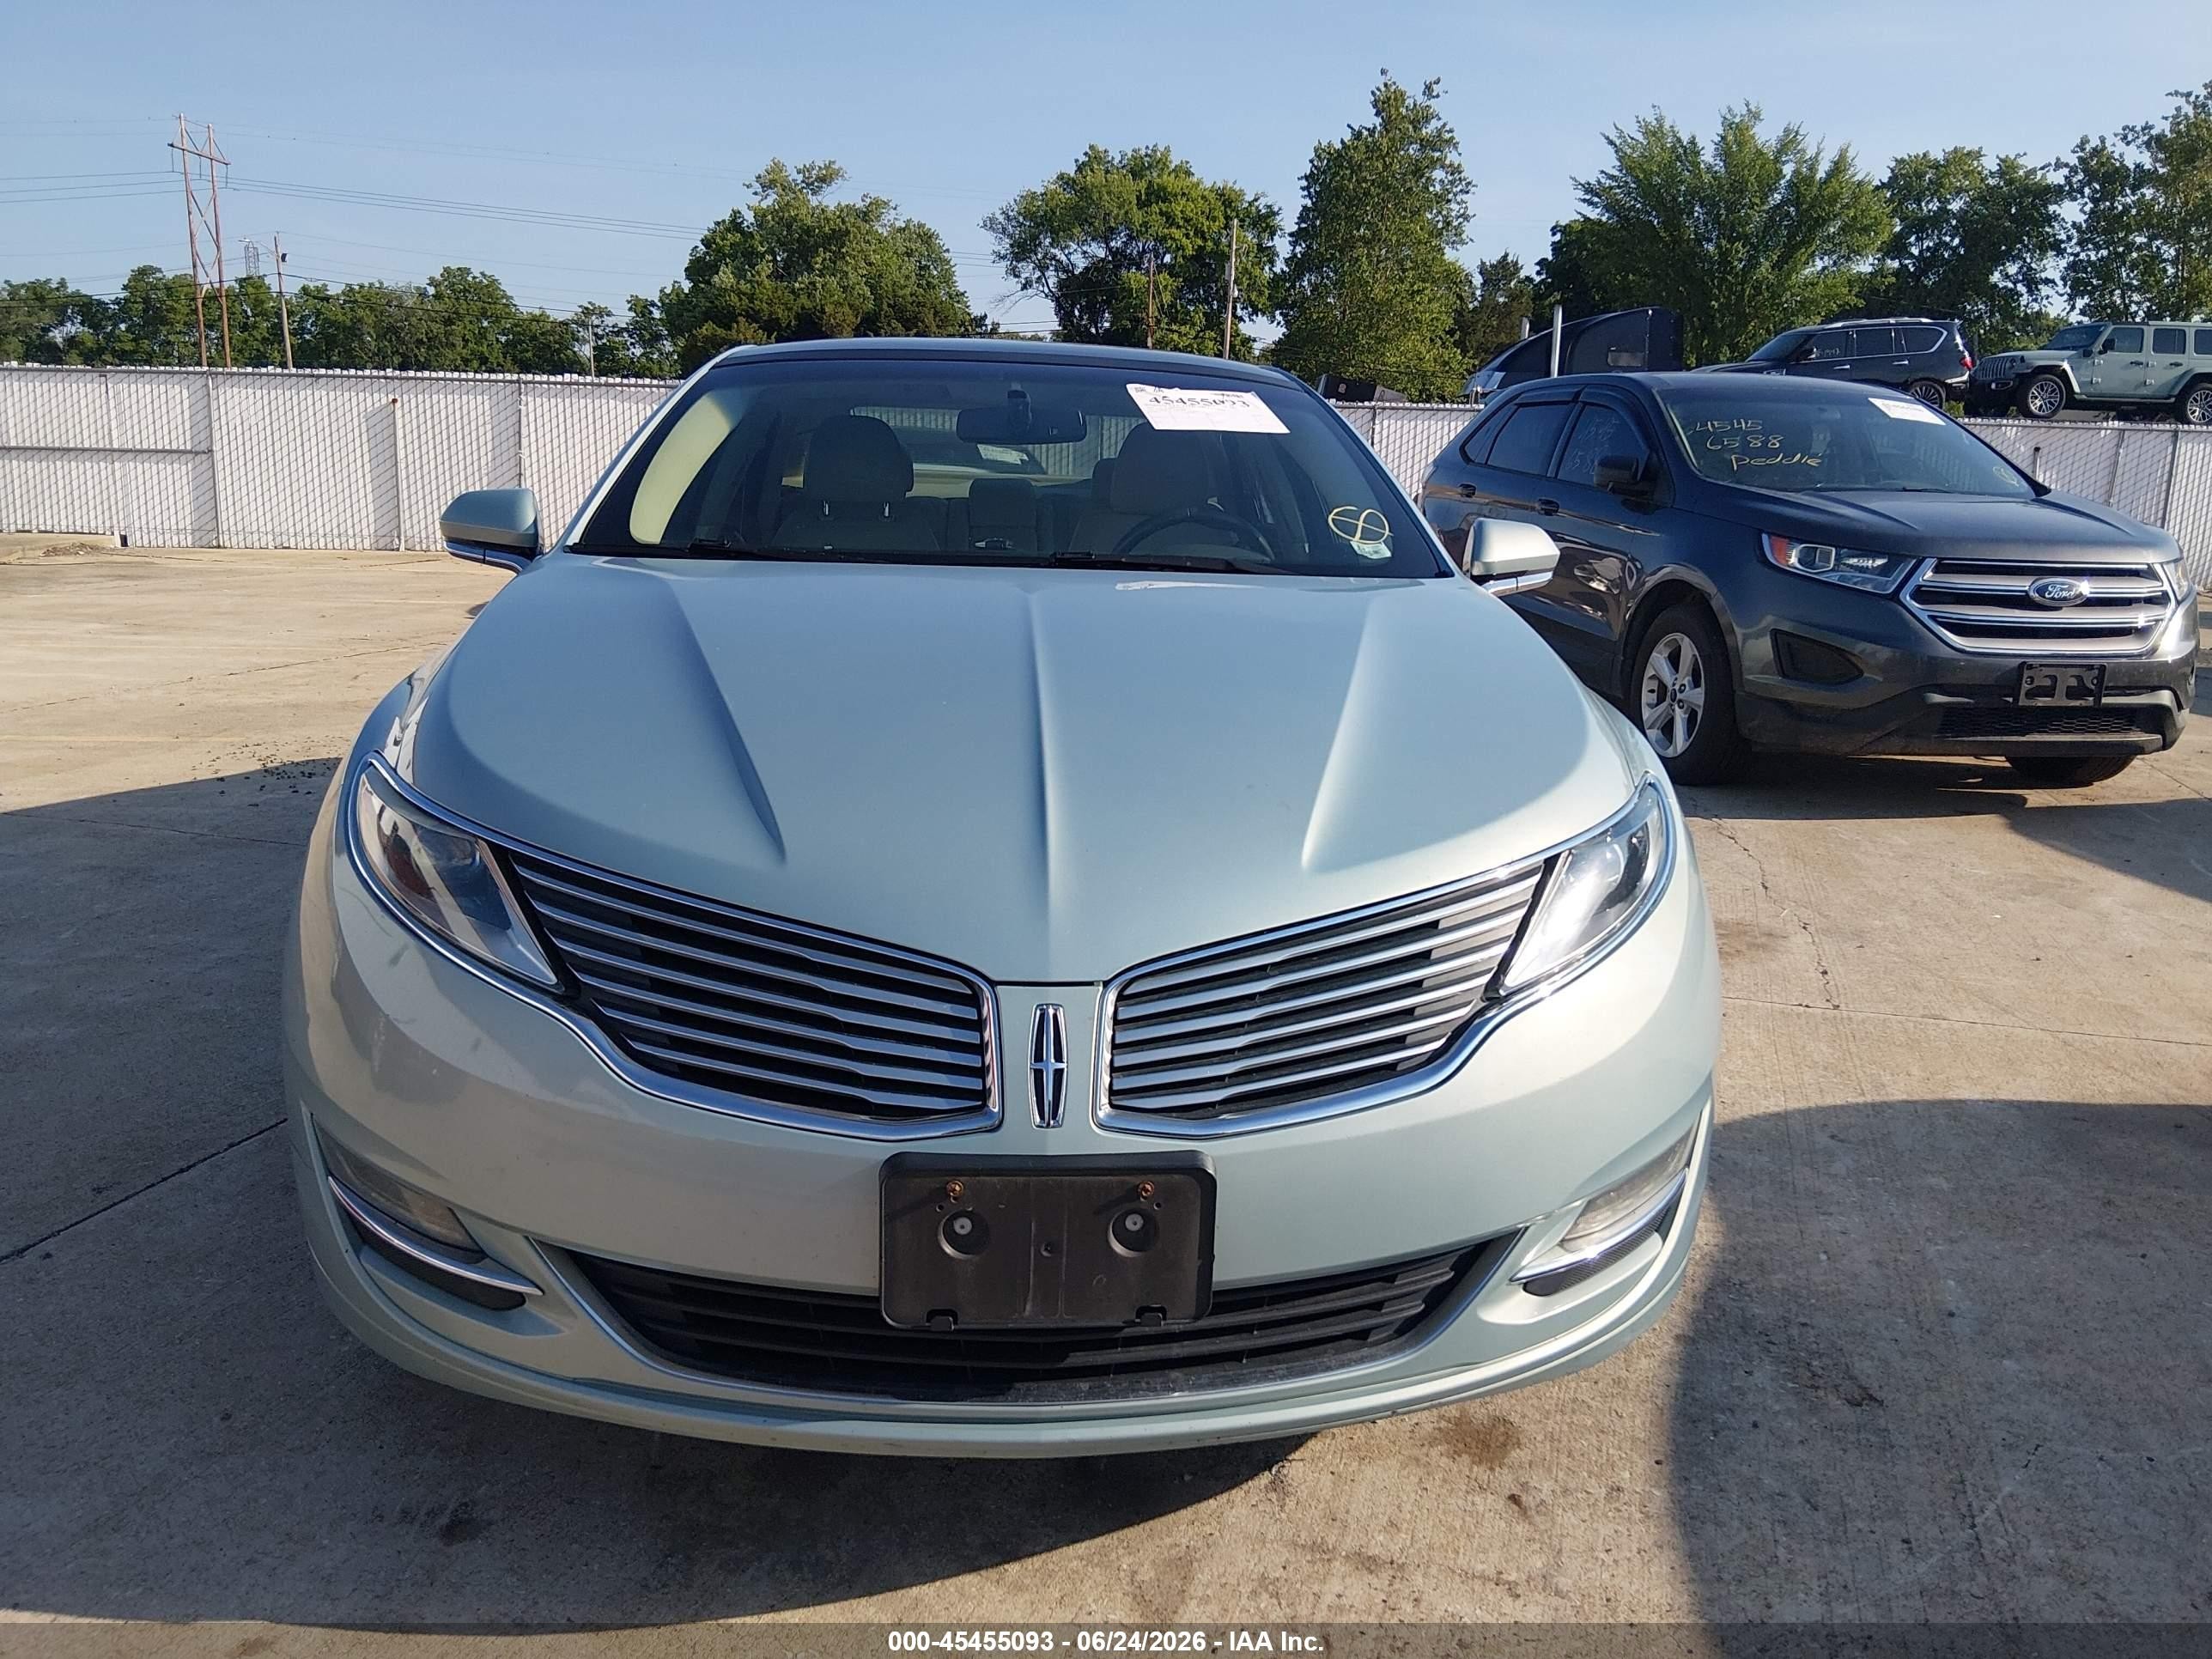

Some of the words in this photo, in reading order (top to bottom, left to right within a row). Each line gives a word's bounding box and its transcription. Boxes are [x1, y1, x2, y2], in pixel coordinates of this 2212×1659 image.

[1695, 418, 1763, 433] 4545
[1706, 434, 1784, 450] 6588
[2045, 583, 2076, 599] Ford
